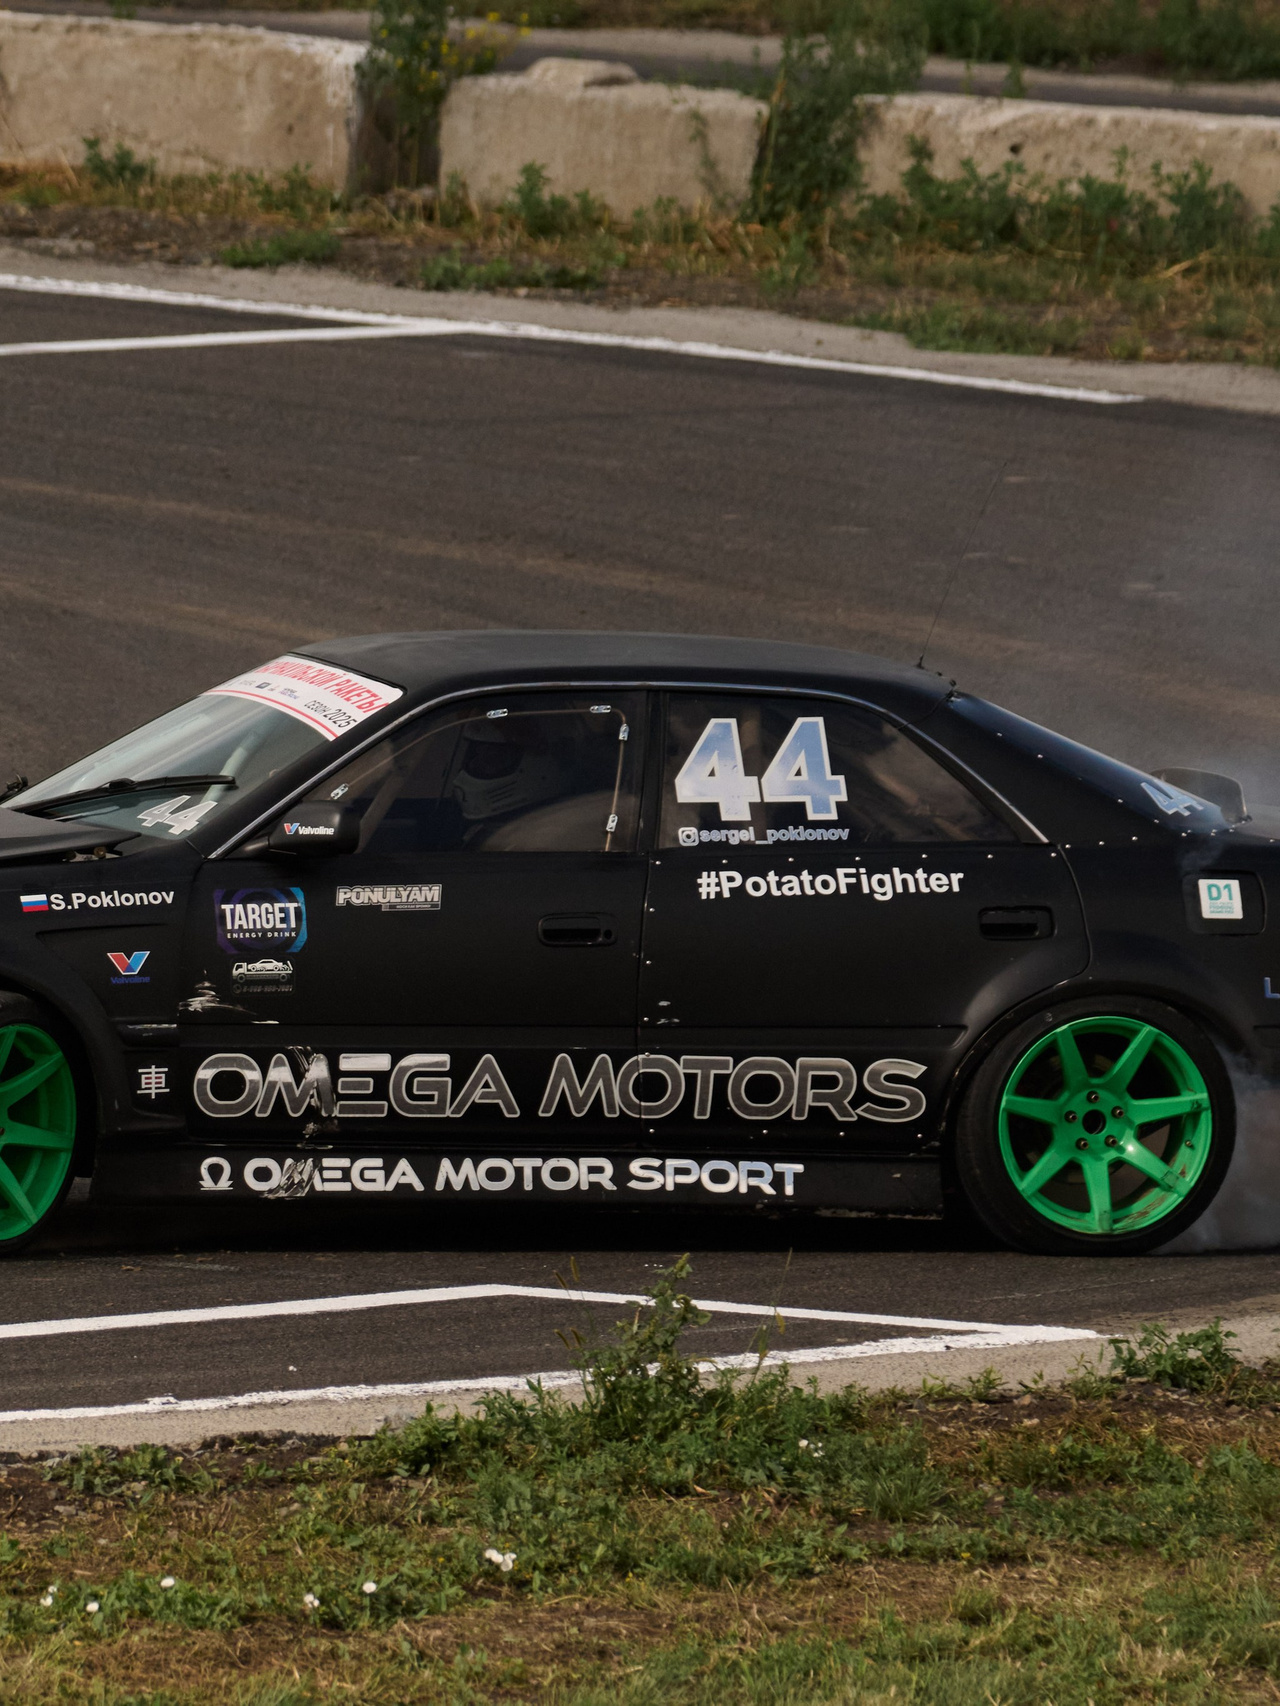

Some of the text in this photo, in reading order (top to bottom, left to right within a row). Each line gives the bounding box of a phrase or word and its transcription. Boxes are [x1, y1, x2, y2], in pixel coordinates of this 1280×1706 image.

[323, 708, 358, 728] 2025
[675, 717, 848, 821] 44
[137, 795, 218, 835] 44
[298, 825, 335, 835] Valvoline
[338, 886, 440, 904] PONULYAM
[697, 867, 964, 901] #PotatoFighter
[1206, 883, 1234, 901] D1
[50, 891, 175, 911] S.Poklonov
[221, 903, 298, 930] TARGET
[110, 975, 151, 984] Valvoline
[137, 1065, 170, 1099] 車
[194, 1053, 928, 1123] OMEGA MOTORS
[435, 1157, 618, 1192] MOTOR
[627, 1157, 805, 1196] SPORT
